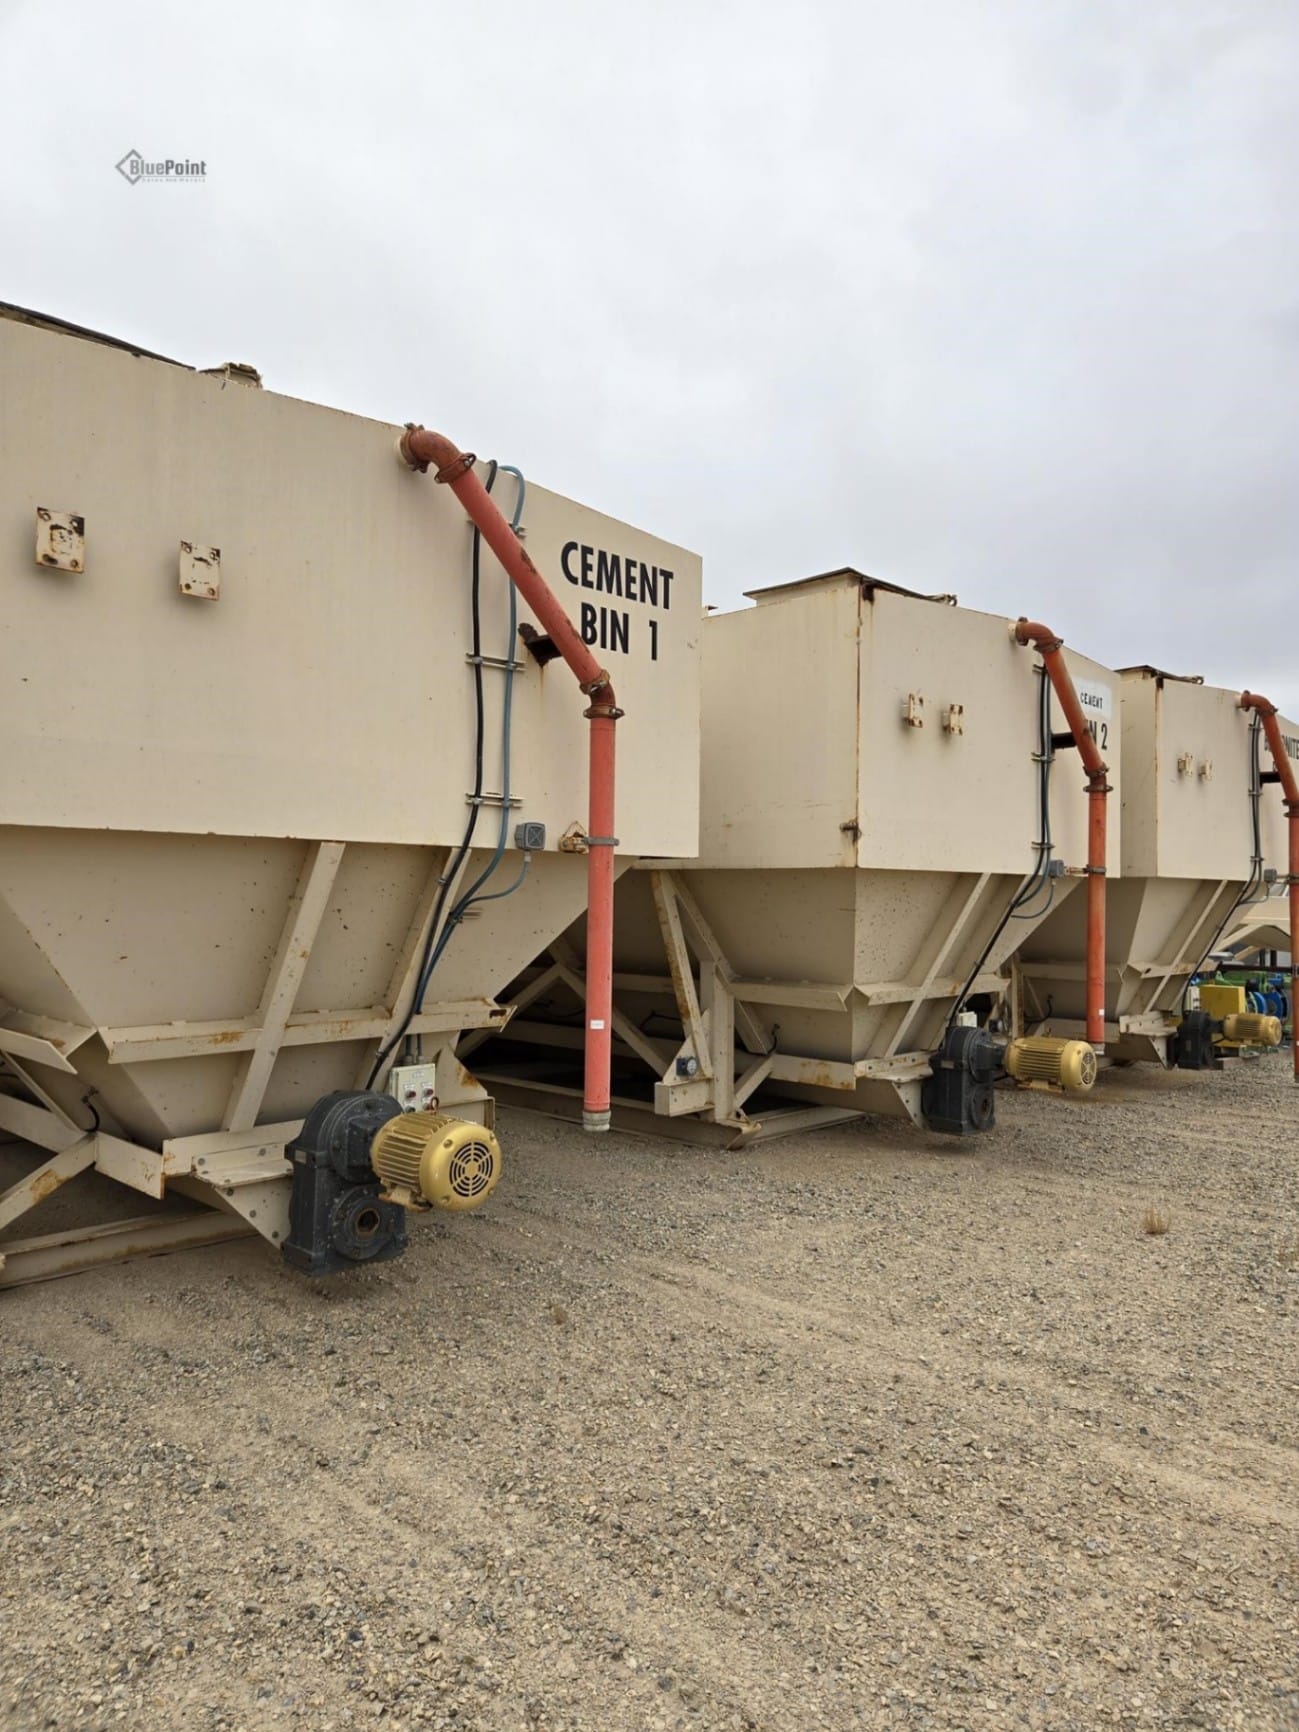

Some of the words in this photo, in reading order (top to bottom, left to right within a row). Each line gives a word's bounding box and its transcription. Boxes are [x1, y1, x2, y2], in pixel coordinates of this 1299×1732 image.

[561, 541, 674, 610] CEMENT
[581, 602, 629, 654] BIN
[649, 619, 658, 661] 1
[1080, 692, 1103, 709] CEMENT
[1101, 723, 1108, 750] 2
